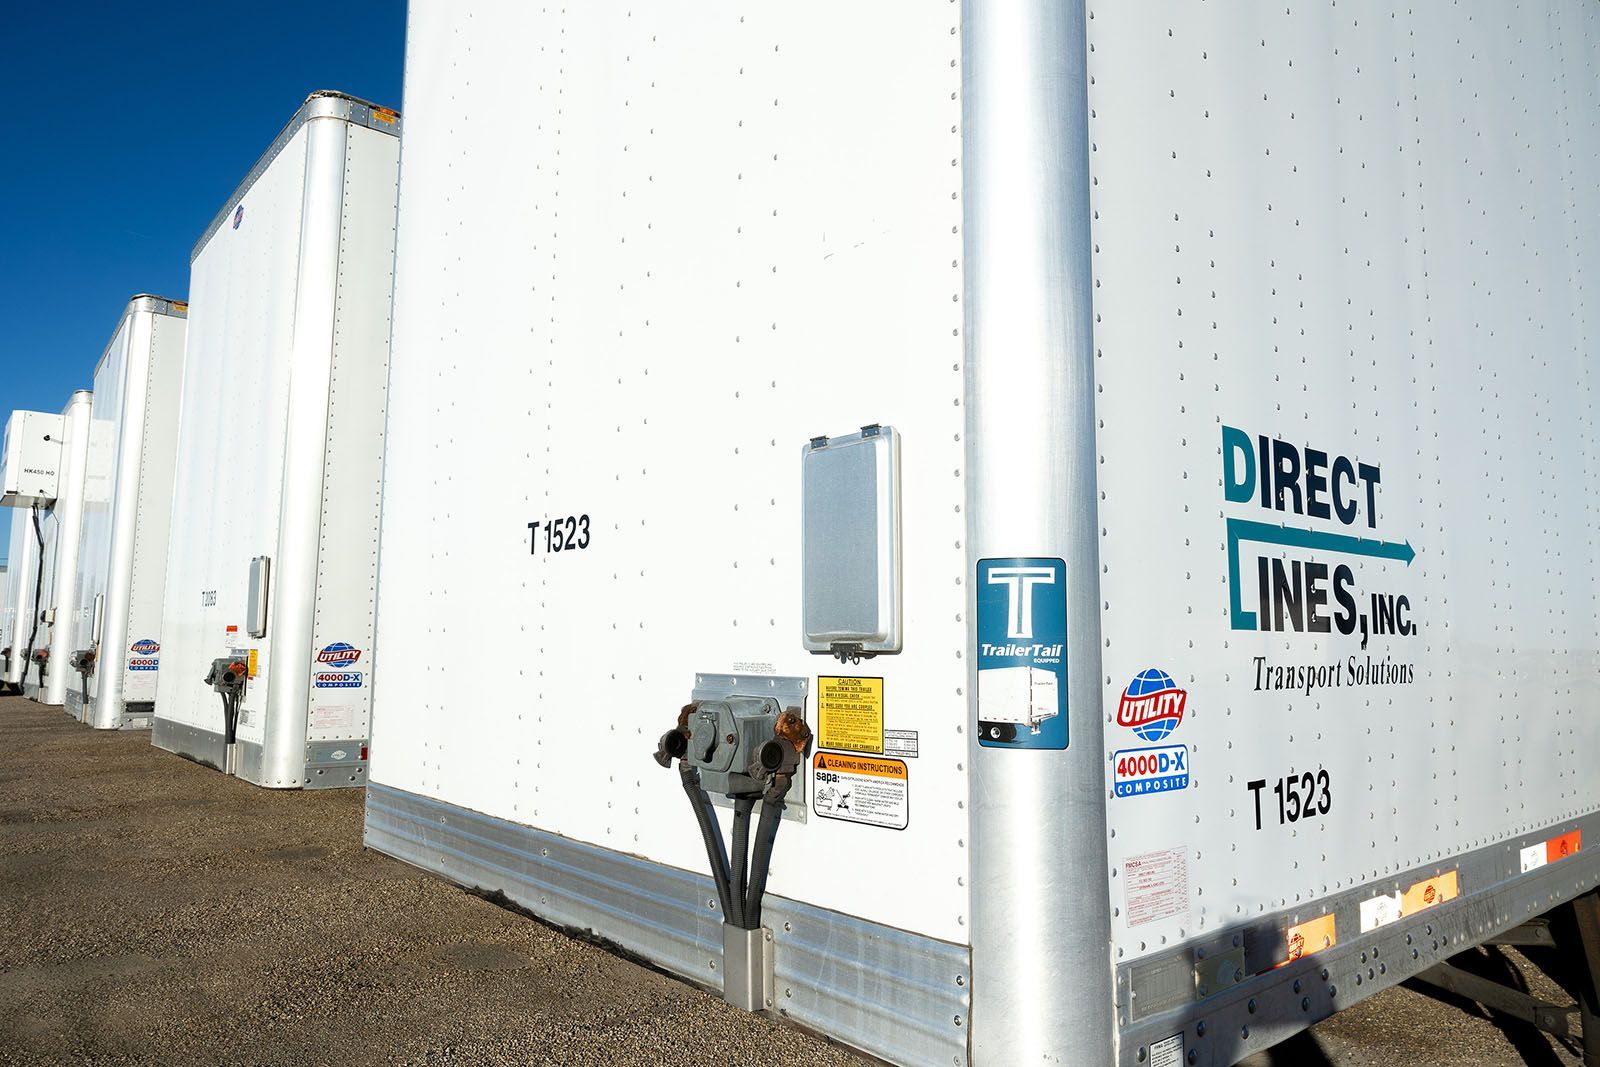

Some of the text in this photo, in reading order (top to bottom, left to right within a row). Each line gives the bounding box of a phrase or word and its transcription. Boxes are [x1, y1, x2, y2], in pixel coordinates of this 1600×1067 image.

[1221, 425, 1382, 529] DIRECT
[528, 514, 590, 555] T 1523
[1371, 593, 1417, 636] INC.
[320, 650, 360, 662] UTILITY
[318, 673, 360, 681] 4000D-X
[1253, 655, 1414, 696] Transport Solutions
[1121, 692, 1184, 723] UTILITY
[827, 758, 903, 775] CLEANING INSTRUCTIONS
[1117, 751, 1185, 777] 4000D-X
[1117, 777, 1187, 795] COMPOSITE
[1247, 769, 1331, 830] T 1523
